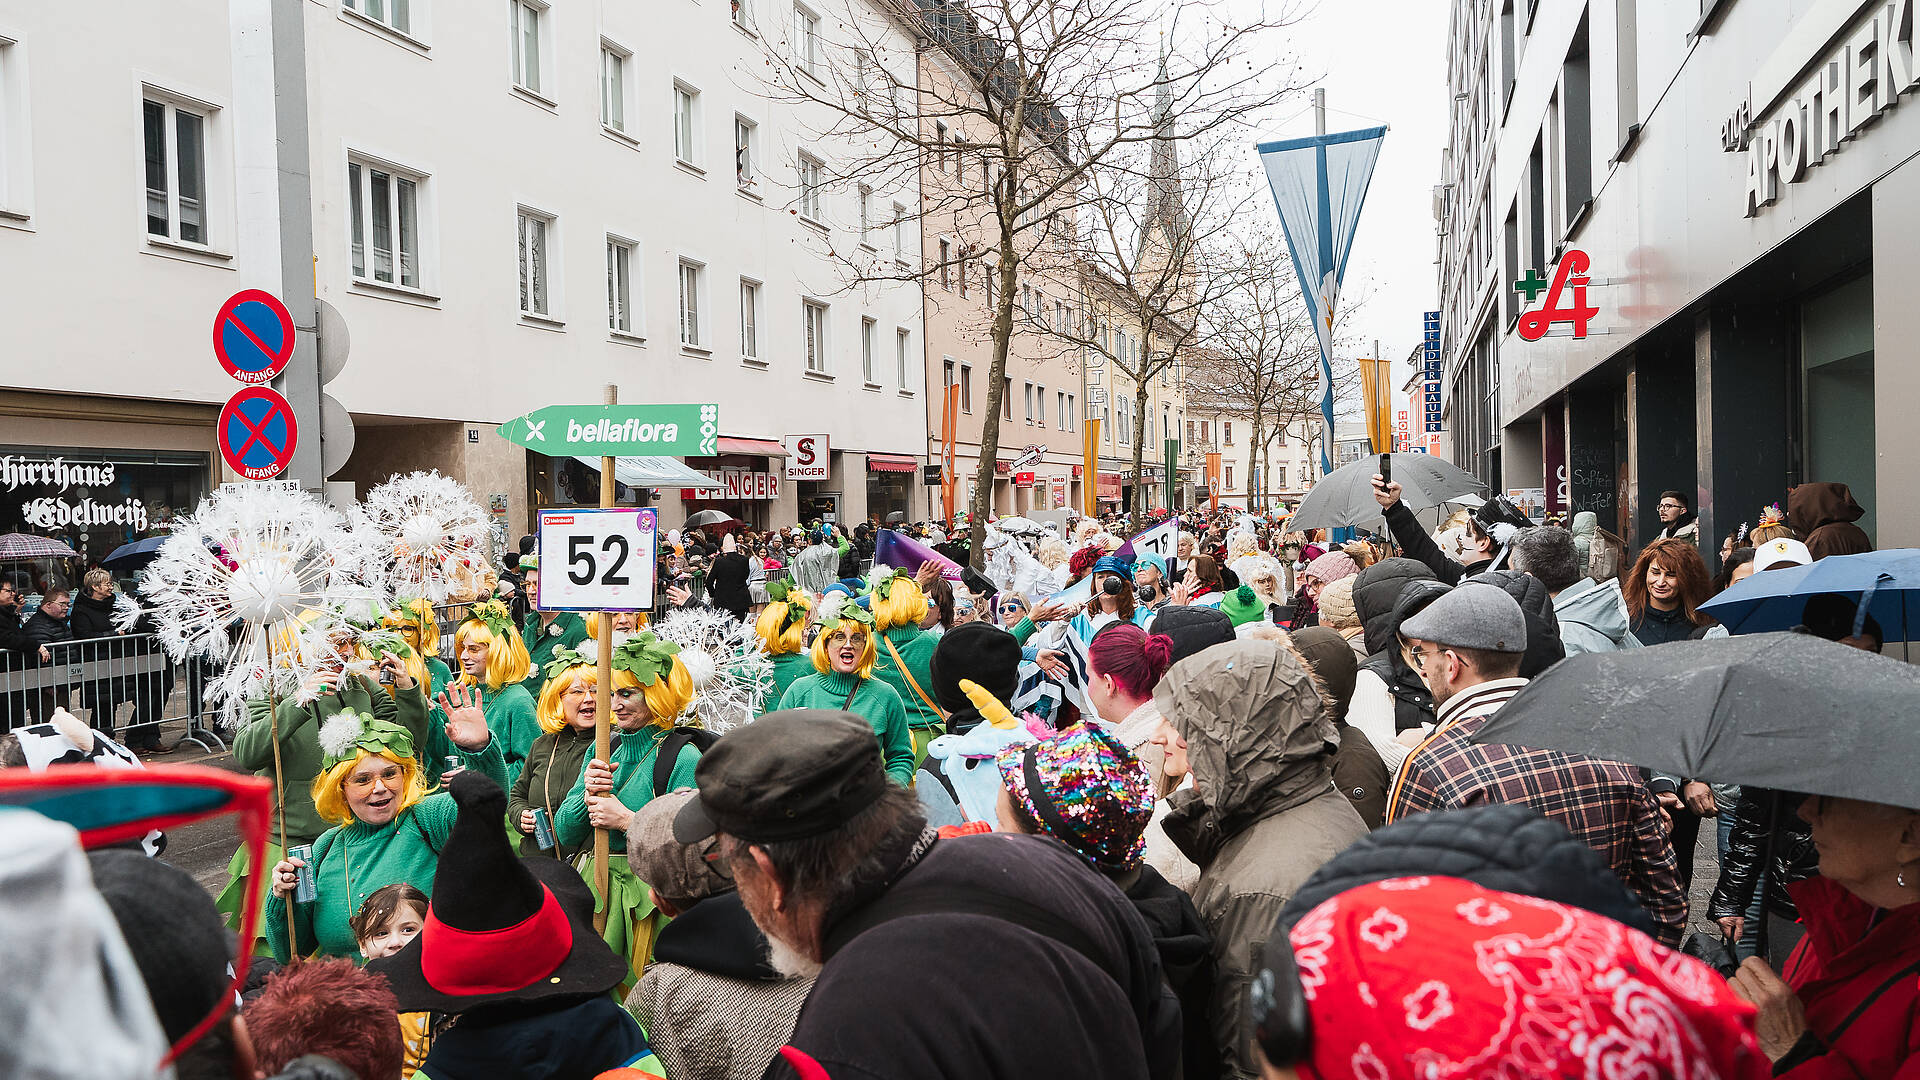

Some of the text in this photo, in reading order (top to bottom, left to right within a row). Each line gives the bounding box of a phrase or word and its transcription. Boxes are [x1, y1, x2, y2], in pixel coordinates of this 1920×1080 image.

[233, 367, 276, 382] ANFANG
[566, 418, 679, 443] bellaflora
[788, 466, 825, 477] SINGER
[282, 482, 298, 492] 3,5t
[26, 497, 148, 534] Edelweiß
[567, 534, 630, 586] 52
